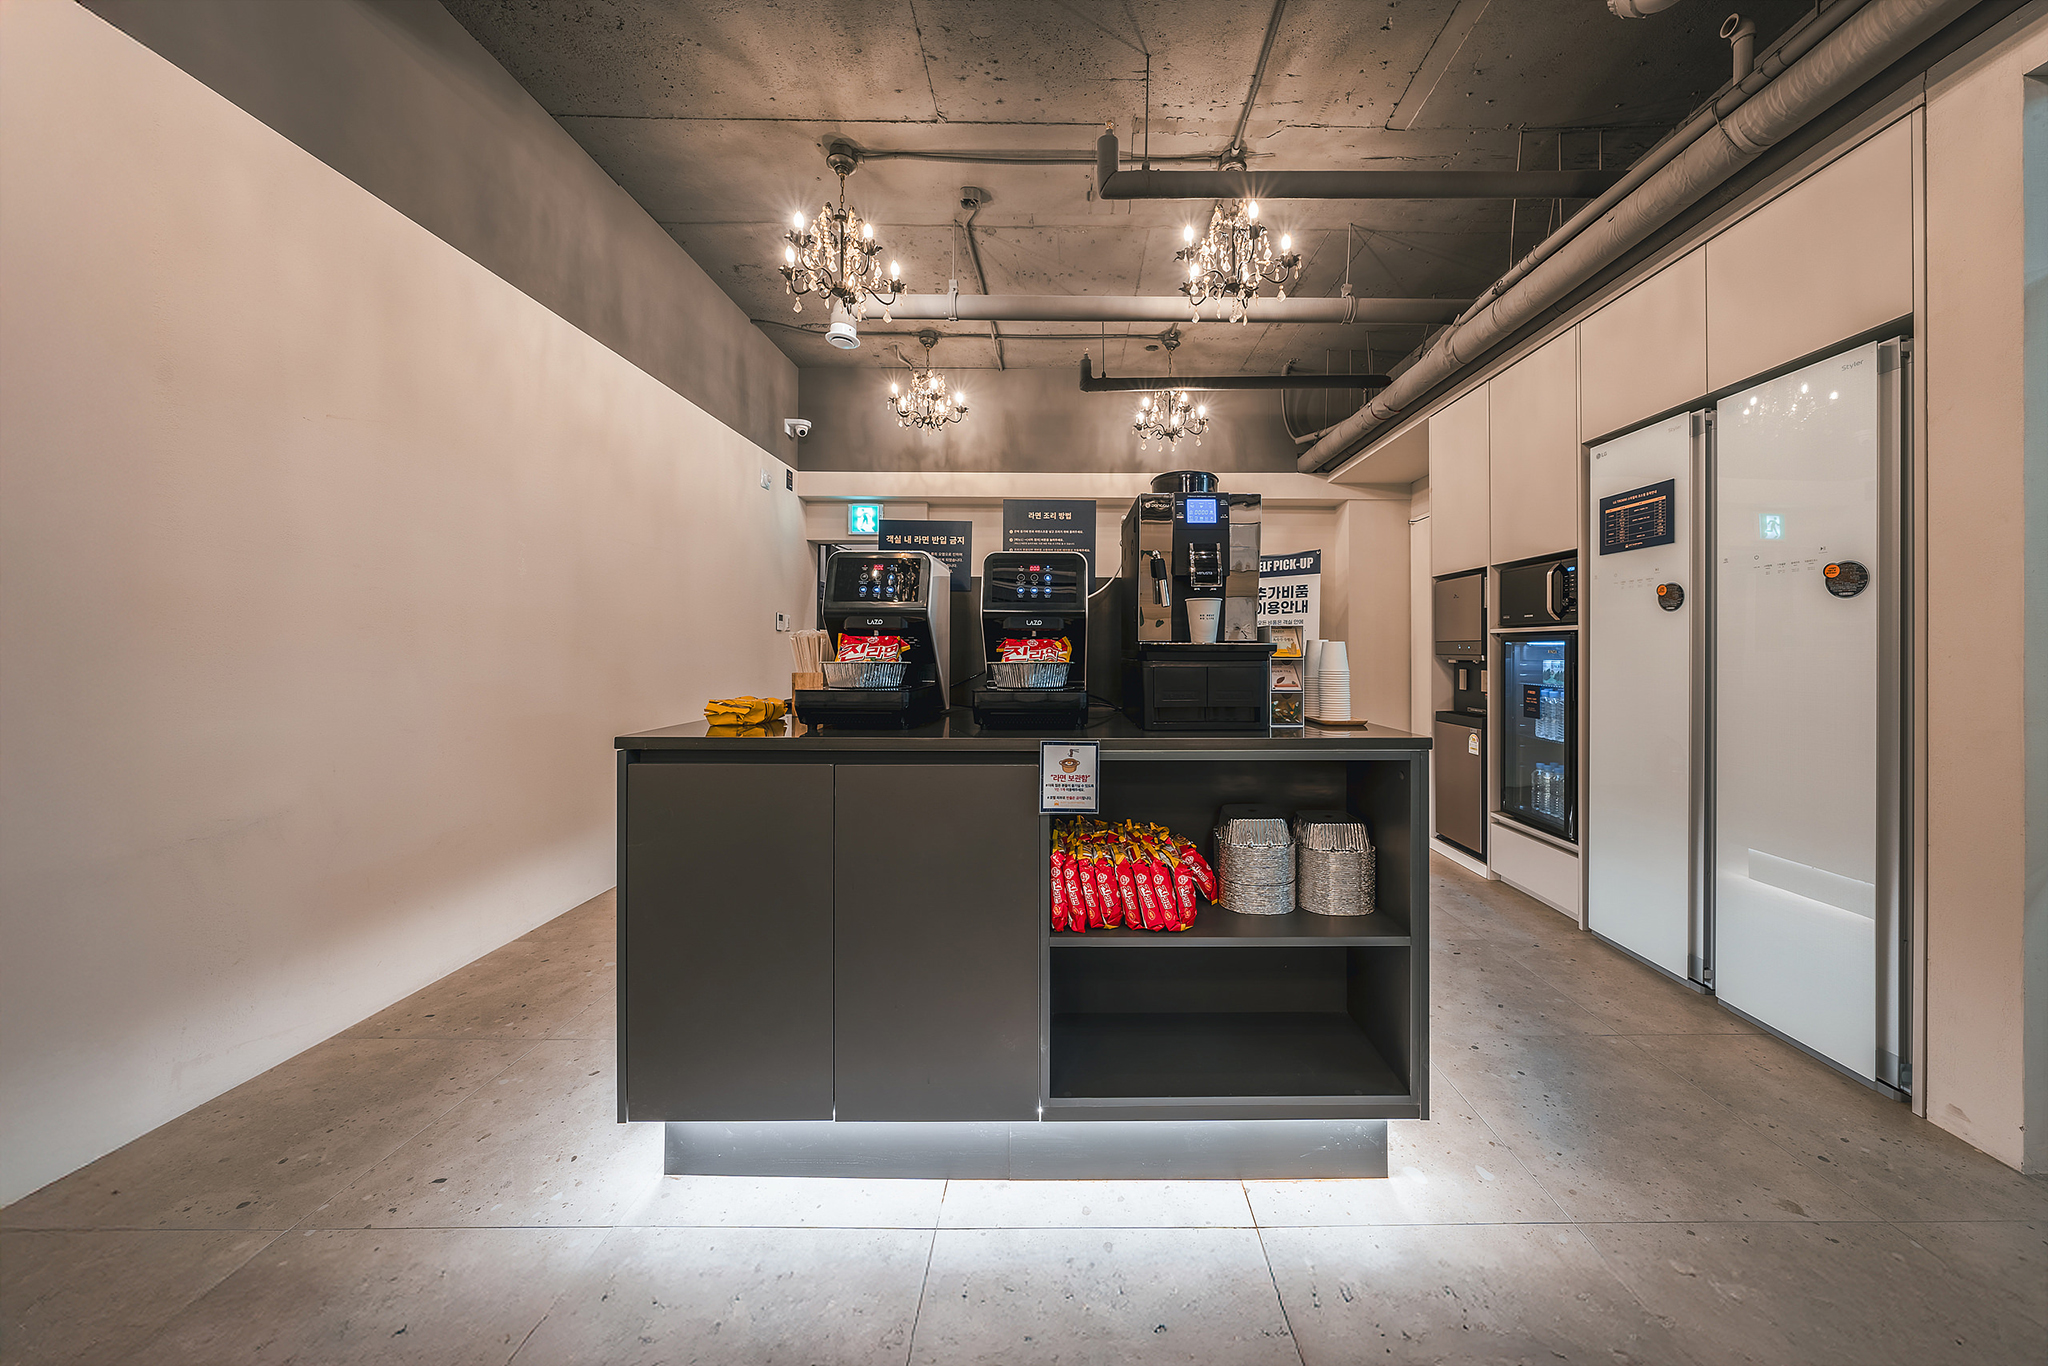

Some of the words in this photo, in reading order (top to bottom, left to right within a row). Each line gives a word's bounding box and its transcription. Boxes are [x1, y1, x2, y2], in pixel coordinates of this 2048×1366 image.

[1841, 360, 1864, 371] Styler
[1028, 511, 1042, 520] 라면
[1043, 511, 1057, 520] 조리
[1058, 511, 1072, 520] 방법
[886, 535, 902, 544] 객실
[903, 535, 912, 544] 내
[913, 535, 930, 545] 라면
[931, 535, 947, 545] 반입
[949, 535, 965, 545] 금지
[1260, 560, 1273, 572] ELF
[1273, 557, 1314, 571] PICK-UP
[1258, 584, 1309, 600] 추가비품
[1257, 600, 1308, 615] 이용안내
[839, 643, 900, 661] 진라면
[1050, 774, 1067, 782] "라면
[1068, 774, 1091, 782] 보관함"
